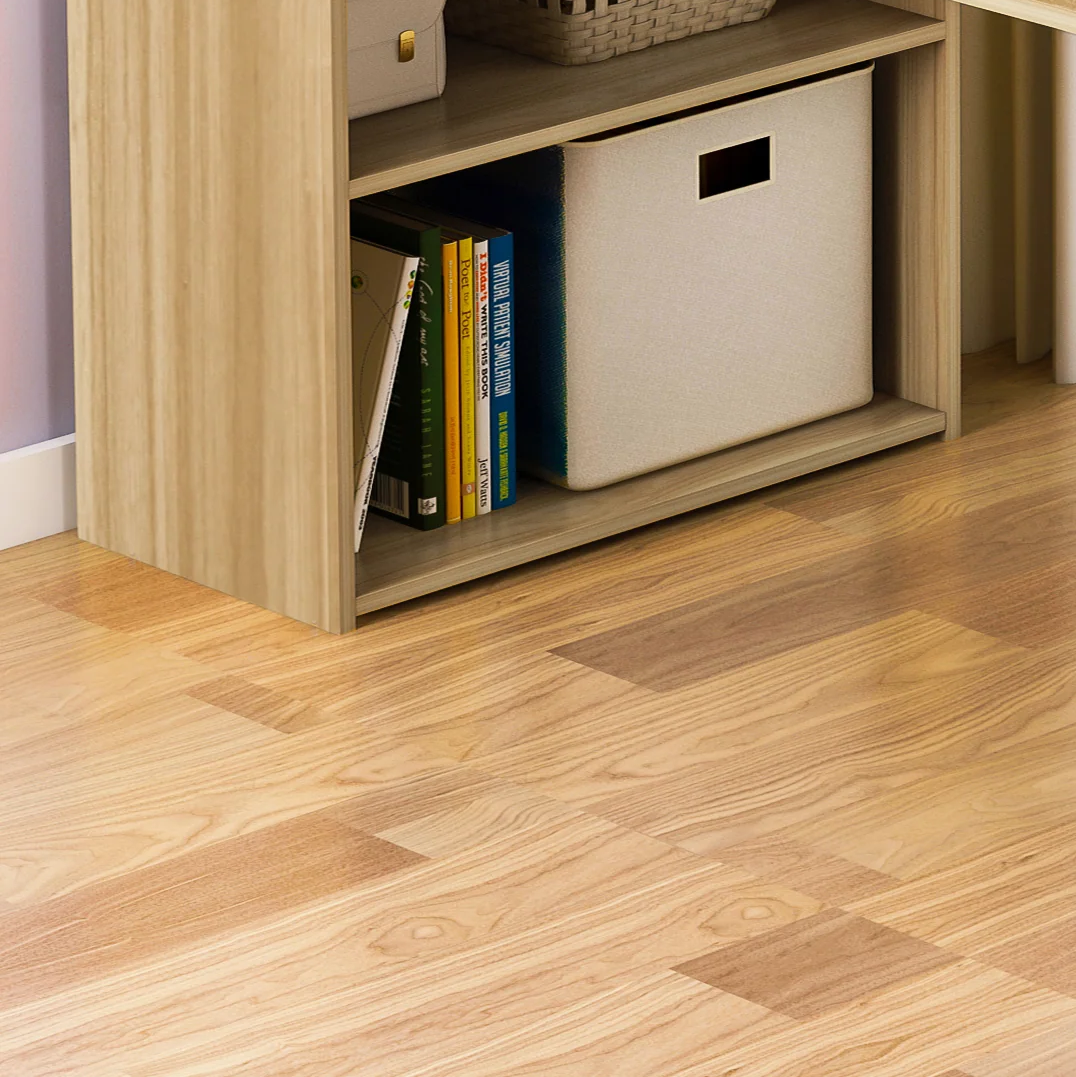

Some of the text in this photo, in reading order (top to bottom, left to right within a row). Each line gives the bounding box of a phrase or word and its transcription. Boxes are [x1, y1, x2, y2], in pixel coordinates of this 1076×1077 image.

[460, 259, 471, 288] Poet
[479, 261, 488, 302] Didn't
[492, 260, 510, 302] VIRTUAL
[461, 310, 472, 340] Poet
[480, 304, 488, 339] WRITE
[493, 302, 511, 340] PATIENT
[480, 341, 488, 367] THIS
[494, 340, 512, 397] SIMULATION
[480, 369, 489, 399] BOOK
[421, 388, 432, 433] SARAH
[477, 458, 489, 508] Jeff Watts
